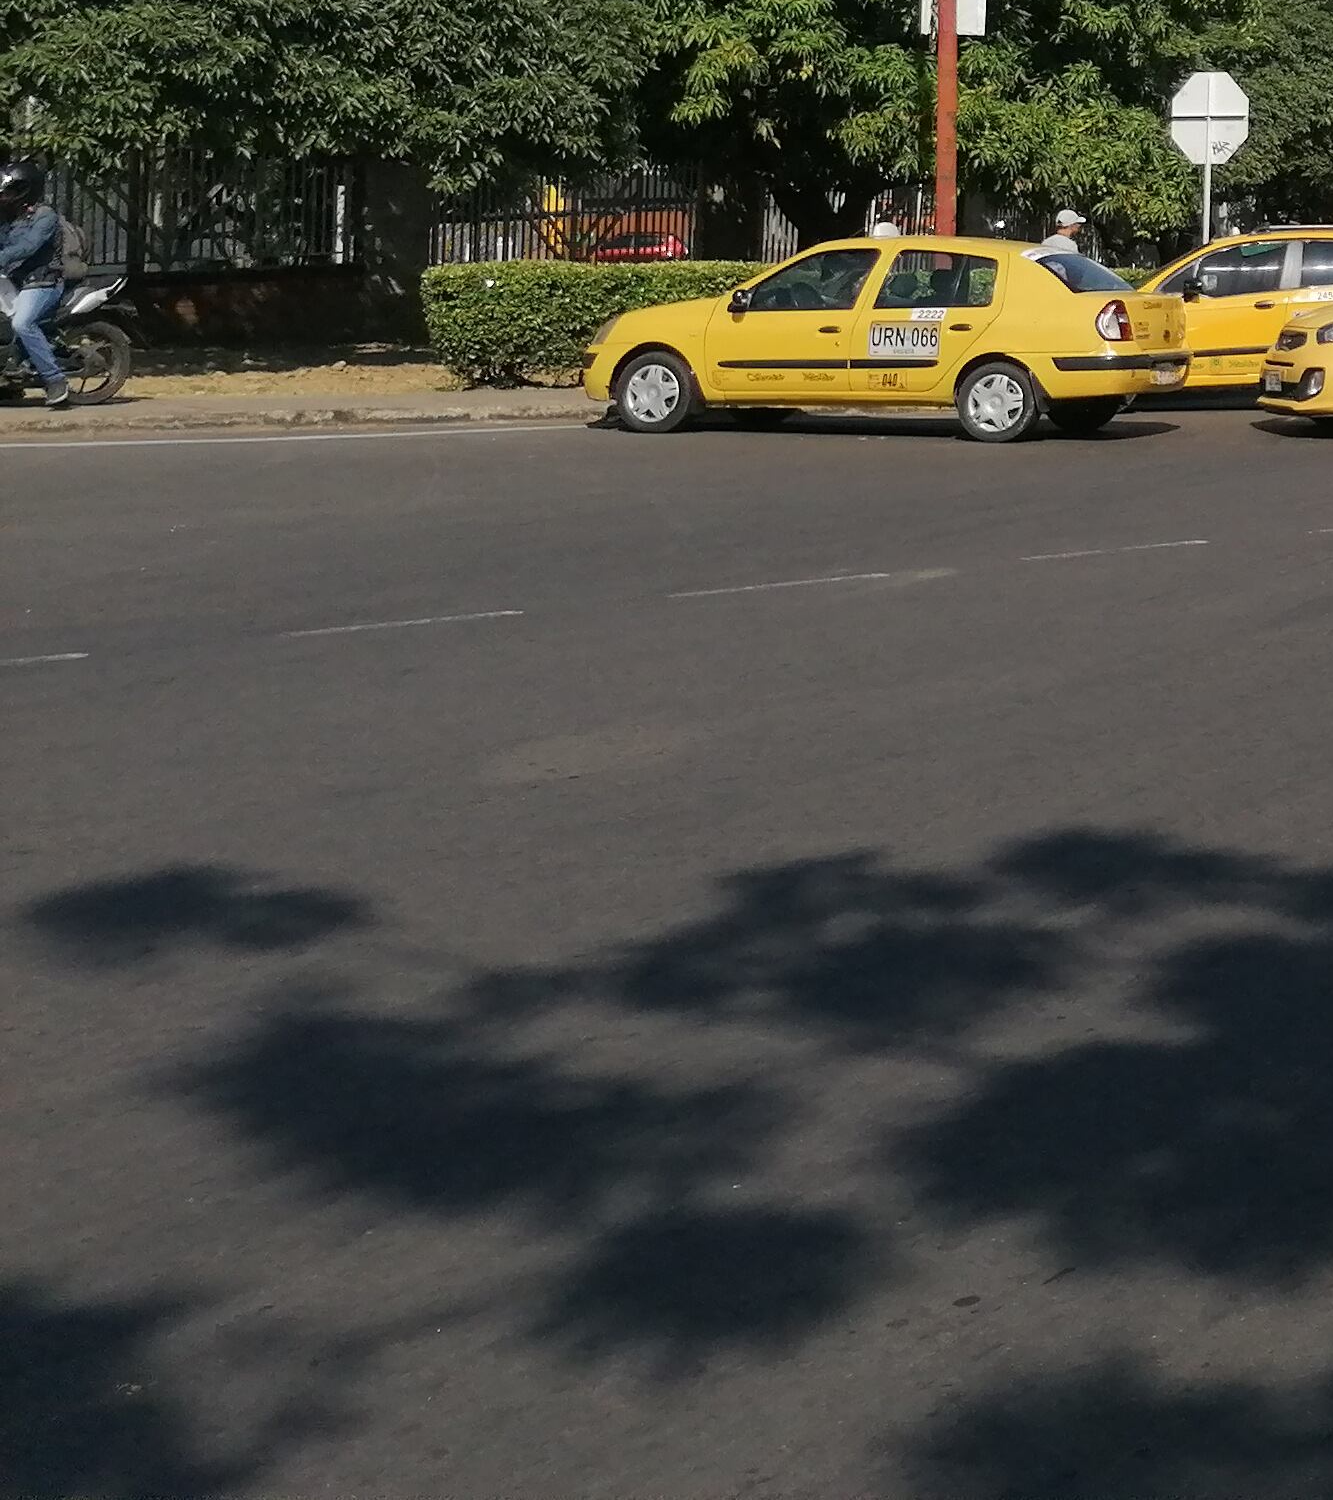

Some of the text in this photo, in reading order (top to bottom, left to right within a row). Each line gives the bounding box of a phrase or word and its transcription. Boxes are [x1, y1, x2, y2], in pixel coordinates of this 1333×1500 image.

[918, 309, 944, 319] 2222
[872, 327, 938, 347] URN 066
